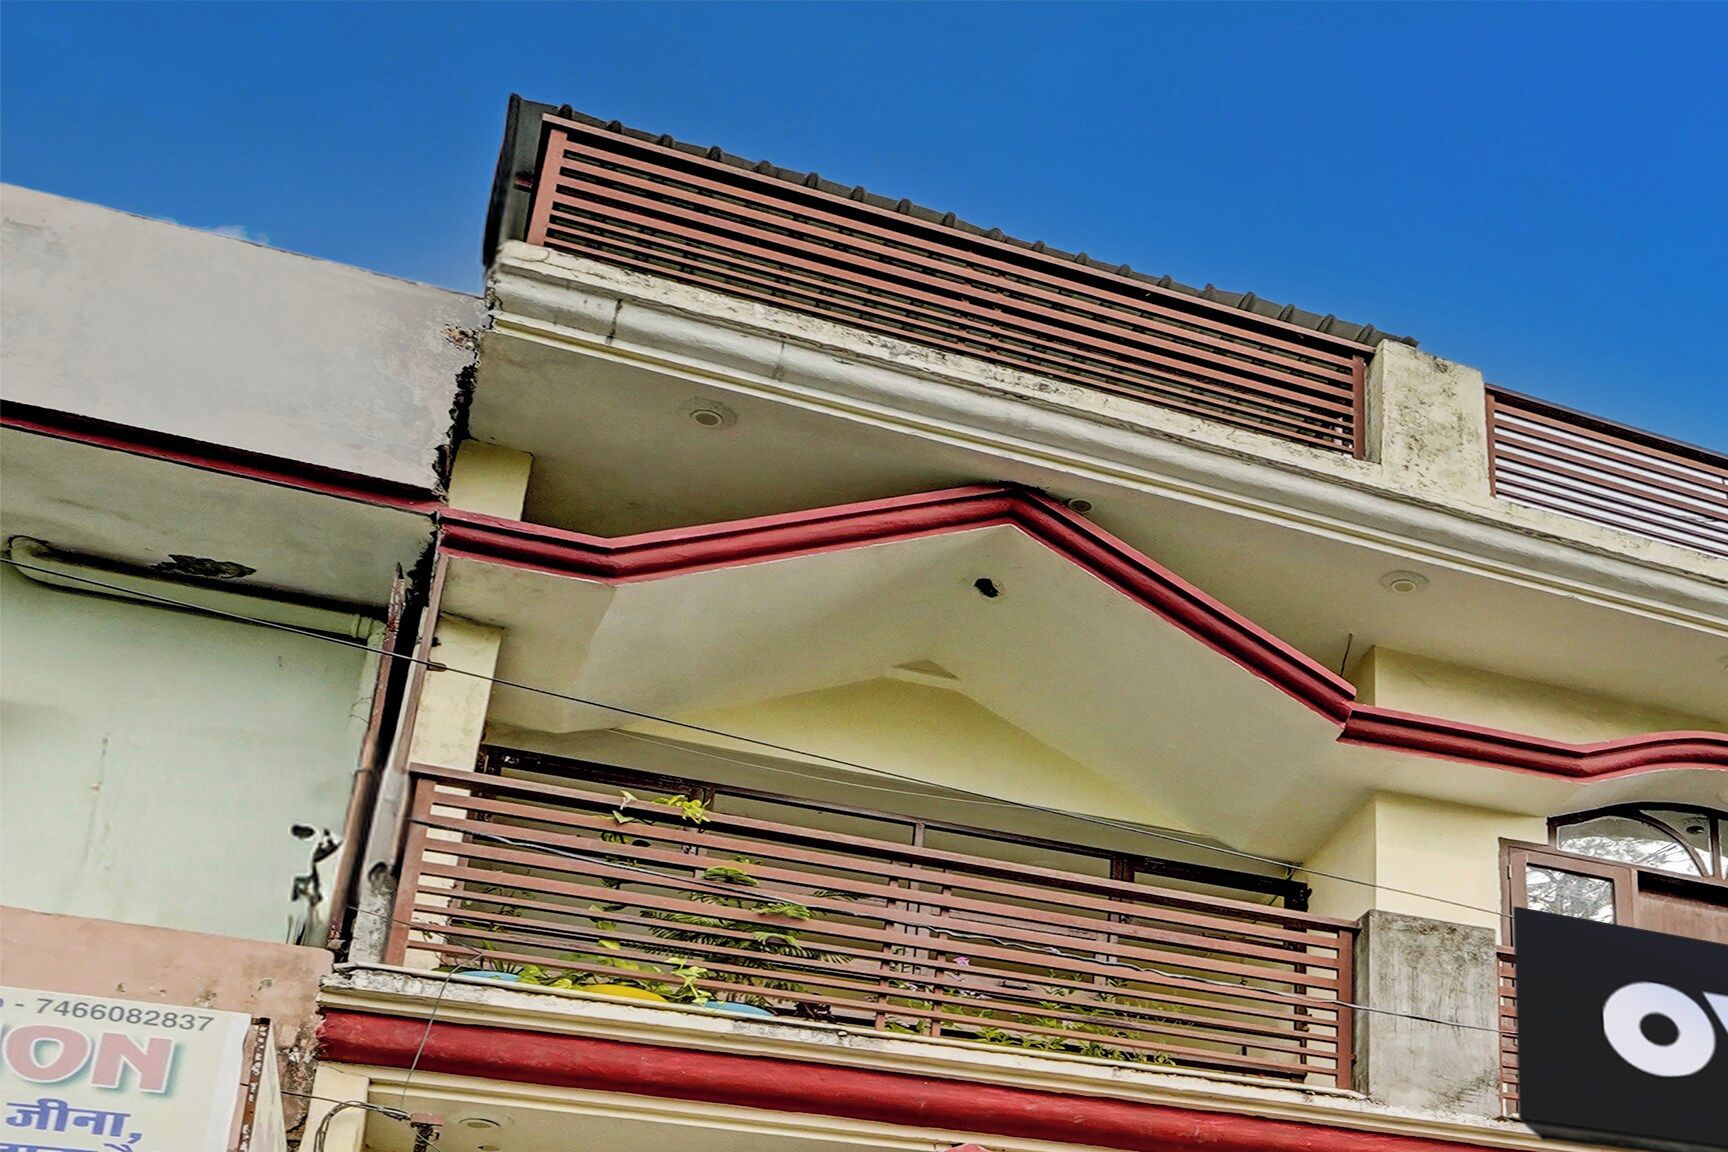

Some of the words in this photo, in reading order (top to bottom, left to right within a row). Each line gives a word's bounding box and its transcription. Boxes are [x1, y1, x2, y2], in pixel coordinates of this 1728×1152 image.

[36, 997, 215, 1032] 7466082837
[0, 1023, 175, 1094] ON
[6, 1098, 143, 1144] जीना,
